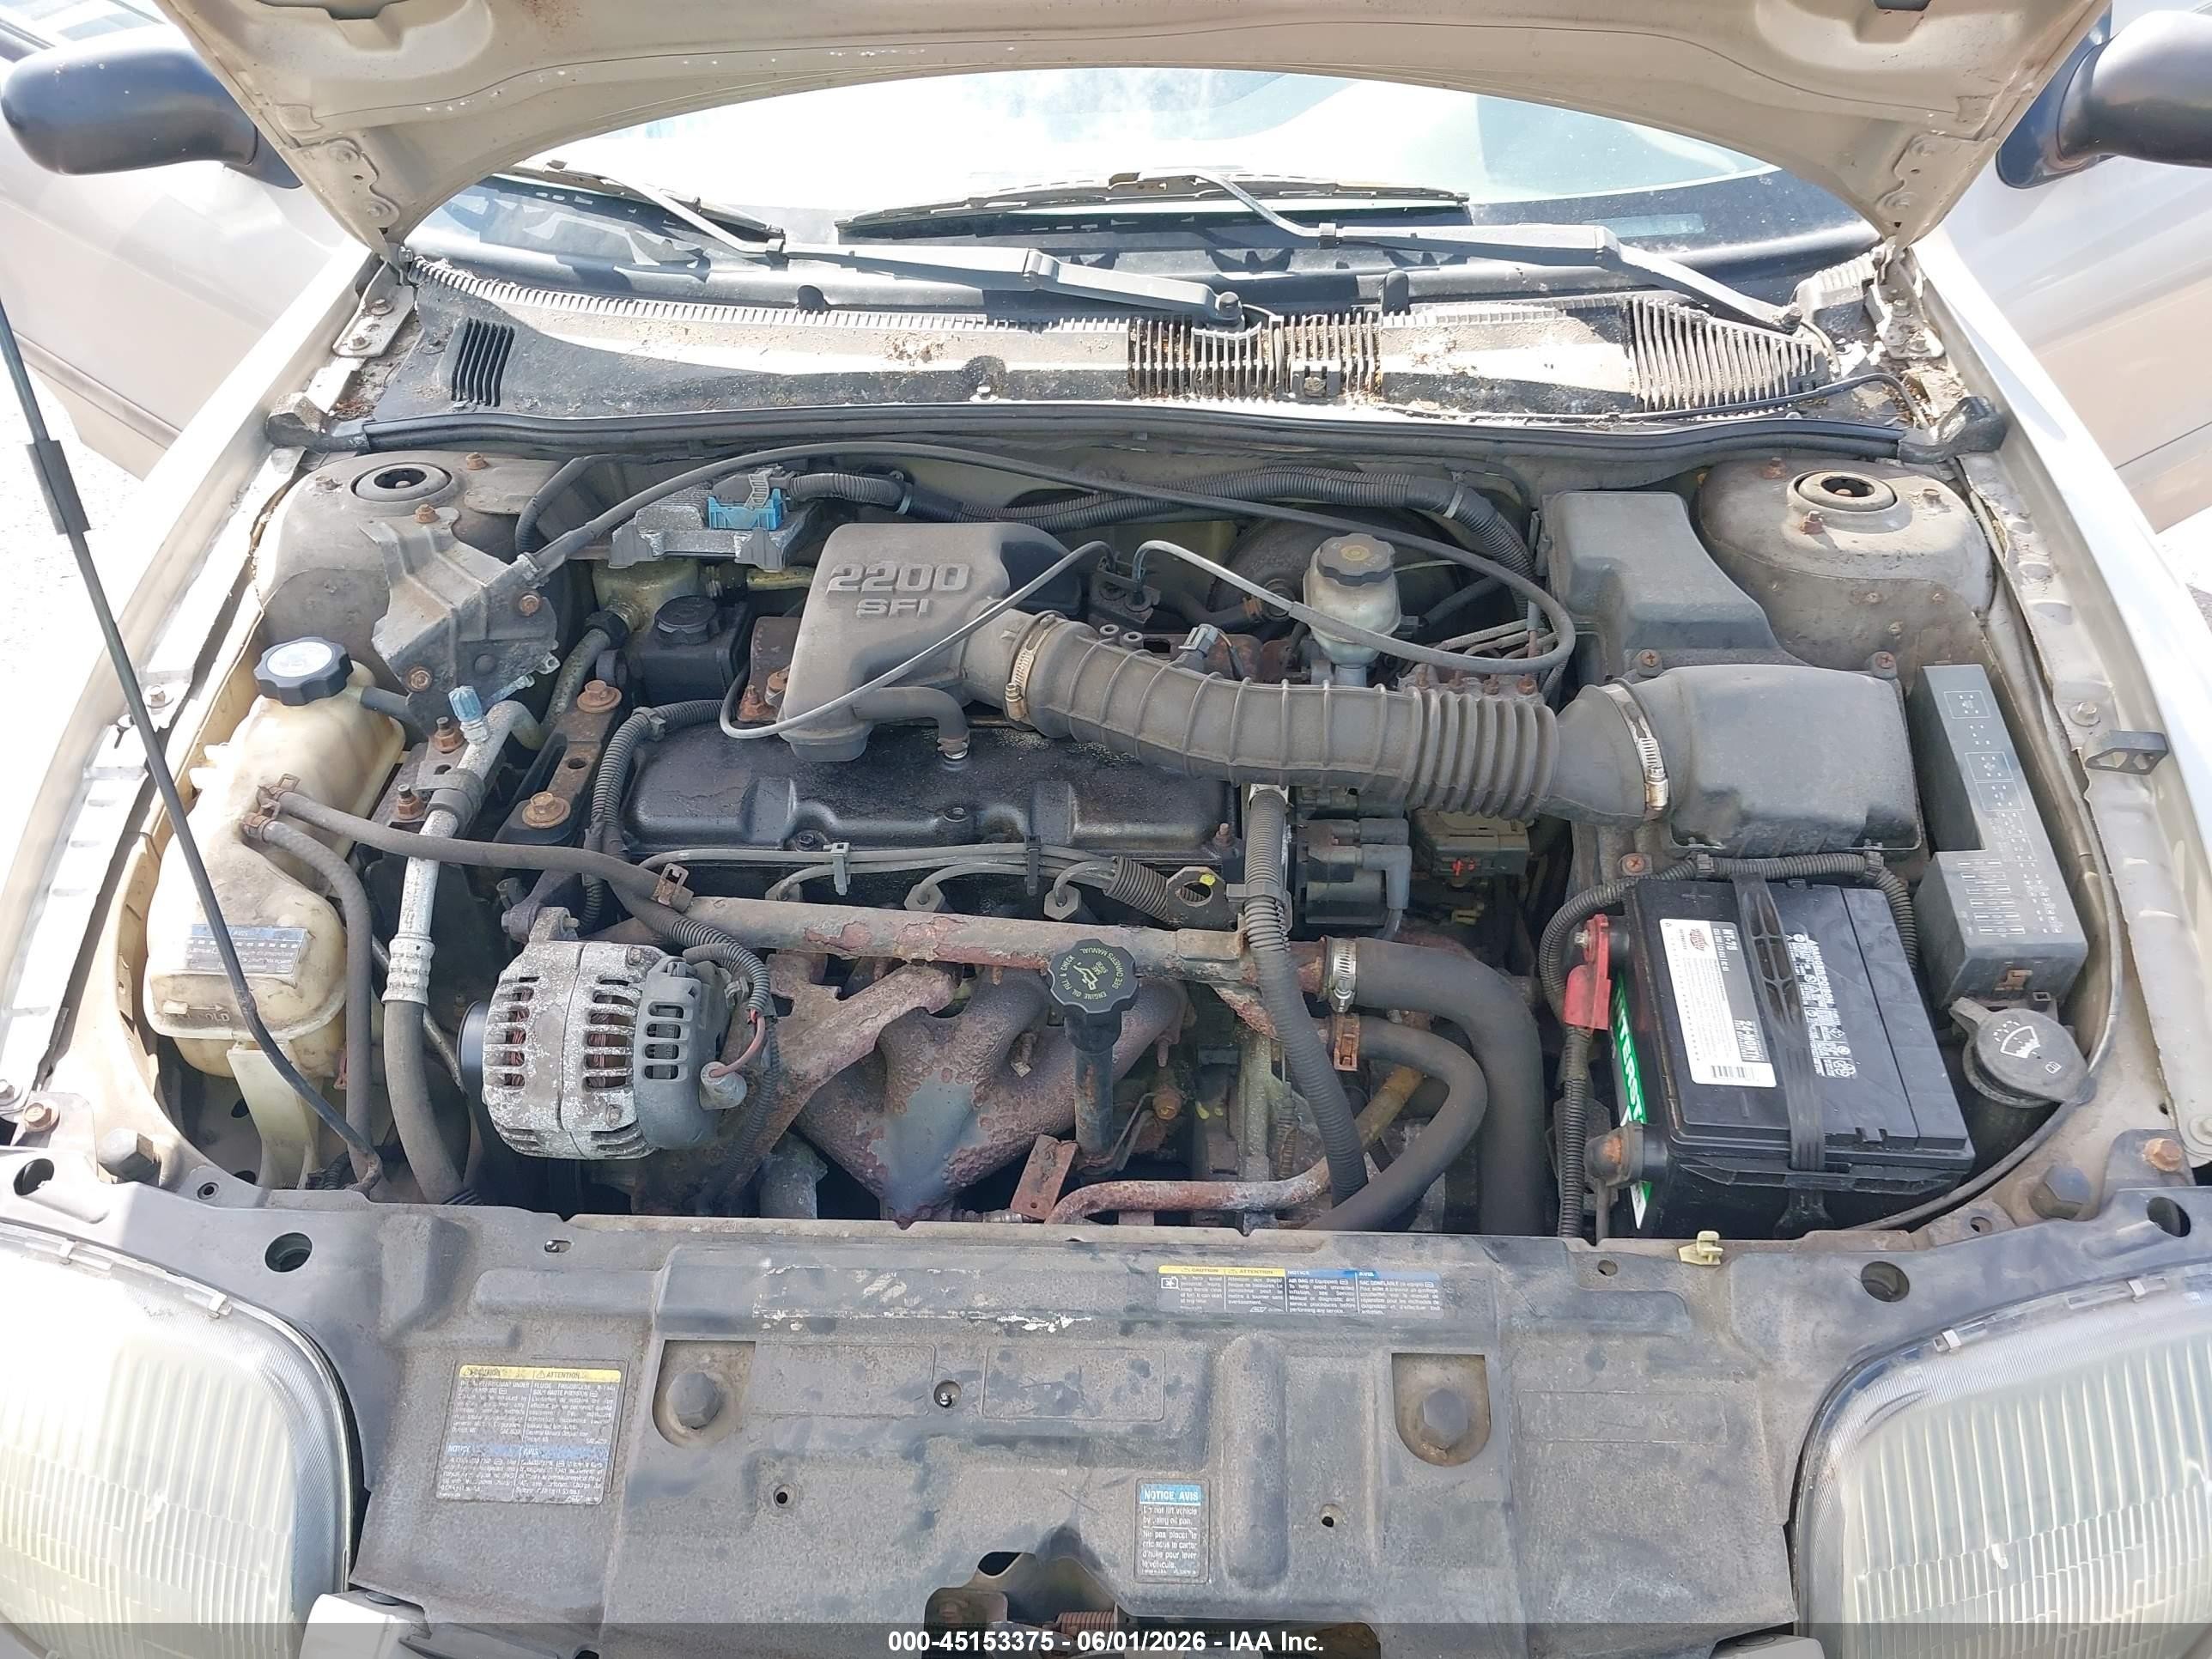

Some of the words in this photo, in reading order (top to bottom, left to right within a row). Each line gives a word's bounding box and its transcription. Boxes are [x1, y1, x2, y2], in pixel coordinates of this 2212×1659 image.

[825, 562, 969, 593] 2200
[857, 599, 929, 617] SFI
[1079, 948, 1107, 957] MANUAL
[1060, 955, 1075, 971] CHECK
[1061, 980, 1072, 990] FILL
[1112, 978, 1123, 989] SEE
[1084, 991, 1107, 1000] ENGINE
[1746, 1020, 1764, 1061] 24-MONTH
[1145, 1491, 1174, 1499] NOTICE
[1180, 1492, 1198, 1501] AVIS
